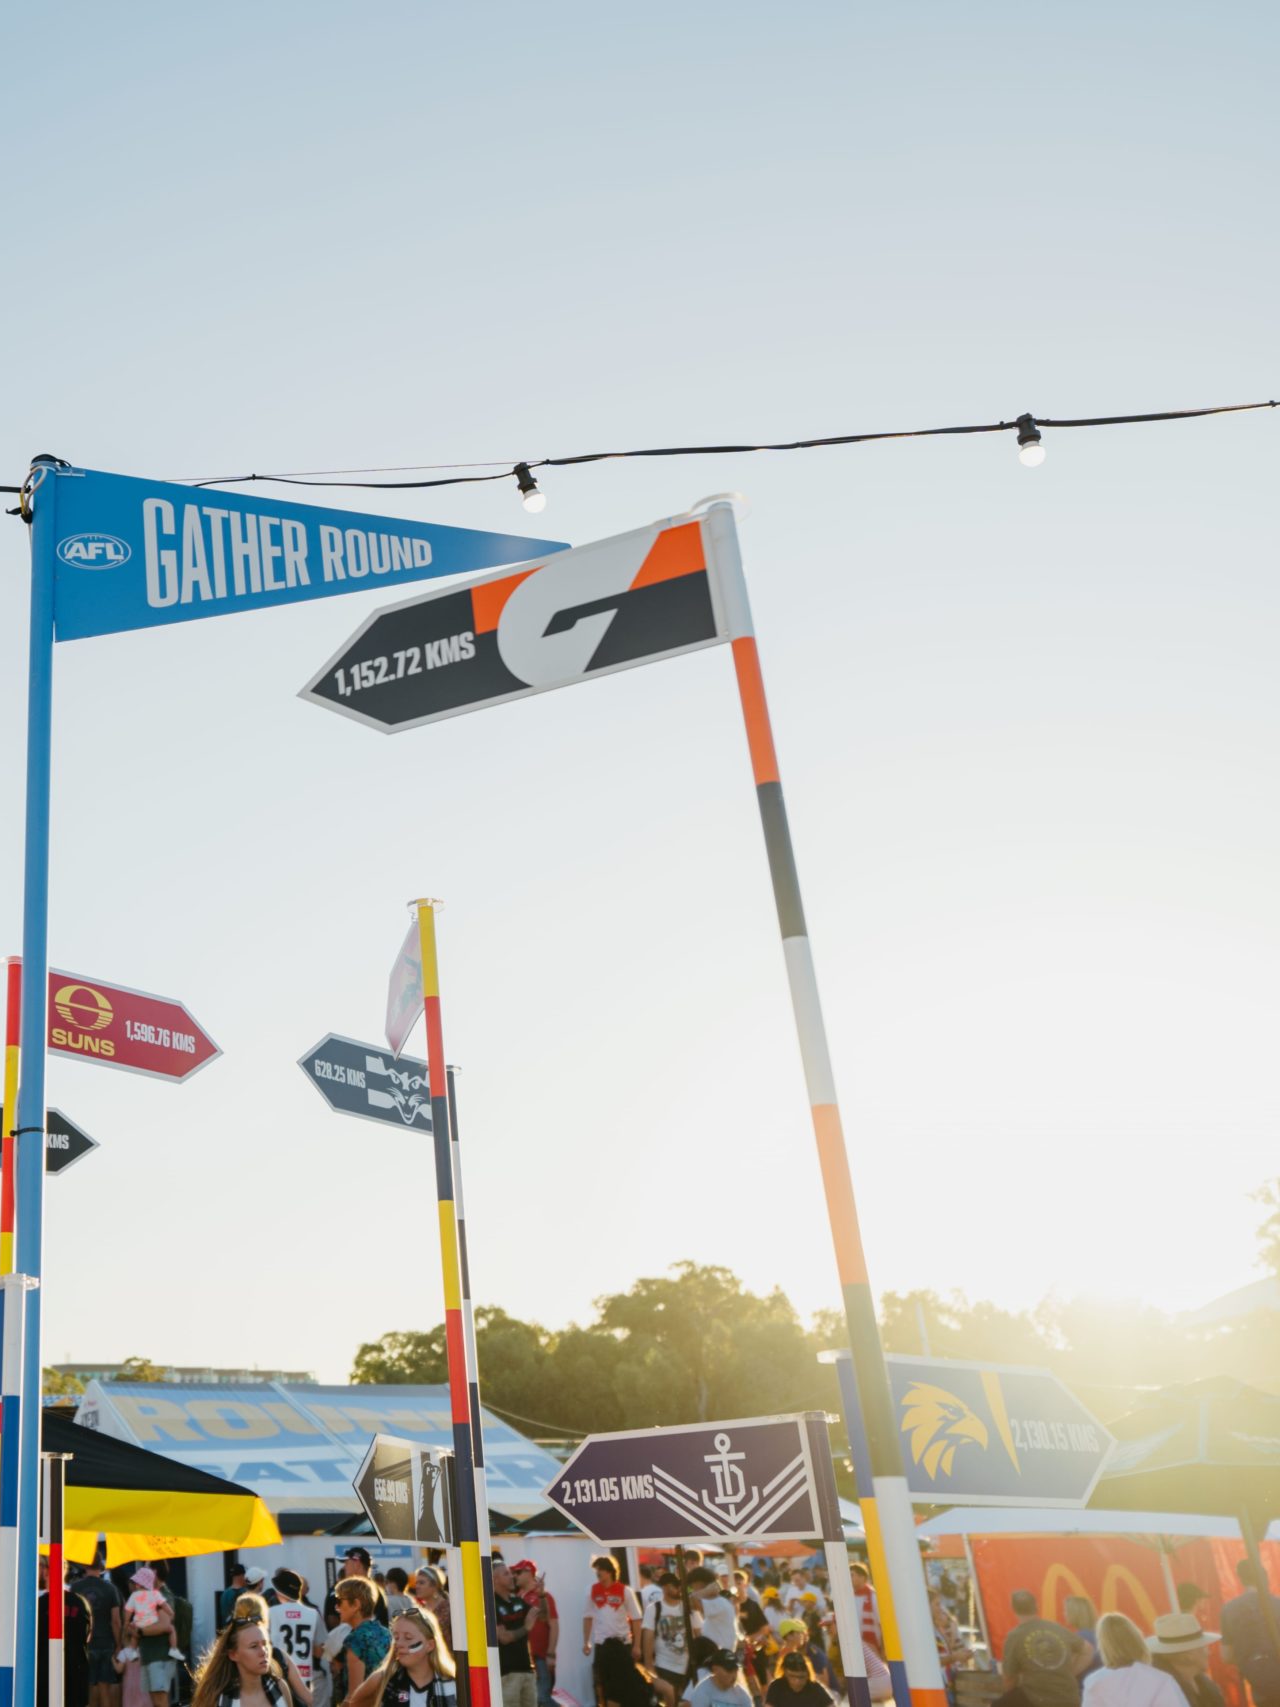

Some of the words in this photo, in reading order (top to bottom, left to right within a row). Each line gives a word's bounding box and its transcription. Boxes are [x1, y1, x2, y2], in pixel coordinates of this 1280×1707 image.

[64, 541, 125, 561] AFL
[142, 498, 311, 608] GATHER
[320, 524, 433, 583] ROUND
[334, 647, 423, 697] 1,152.72
[425, 631, 476, 671] KMS
[51, 1028, 116, 1057] SUNS
[125, 1020, 170, 1047] 1,596.76
[172, 1031, 196, 1054] KMS
[314, 1059, 346, 1083] 628.25
[346, 1068, 366, 1089] KMS
[46, 1133, 70, 1150] KMS
[1066, 1423, 1100, 1453] KMS
[396, 1480, 409, 1504] KMS
[561, 1477, 619, 1506] 2,131.05
[621, 1474, 654, 1500] KMS
[280, 1624, 311, 1660] 35
